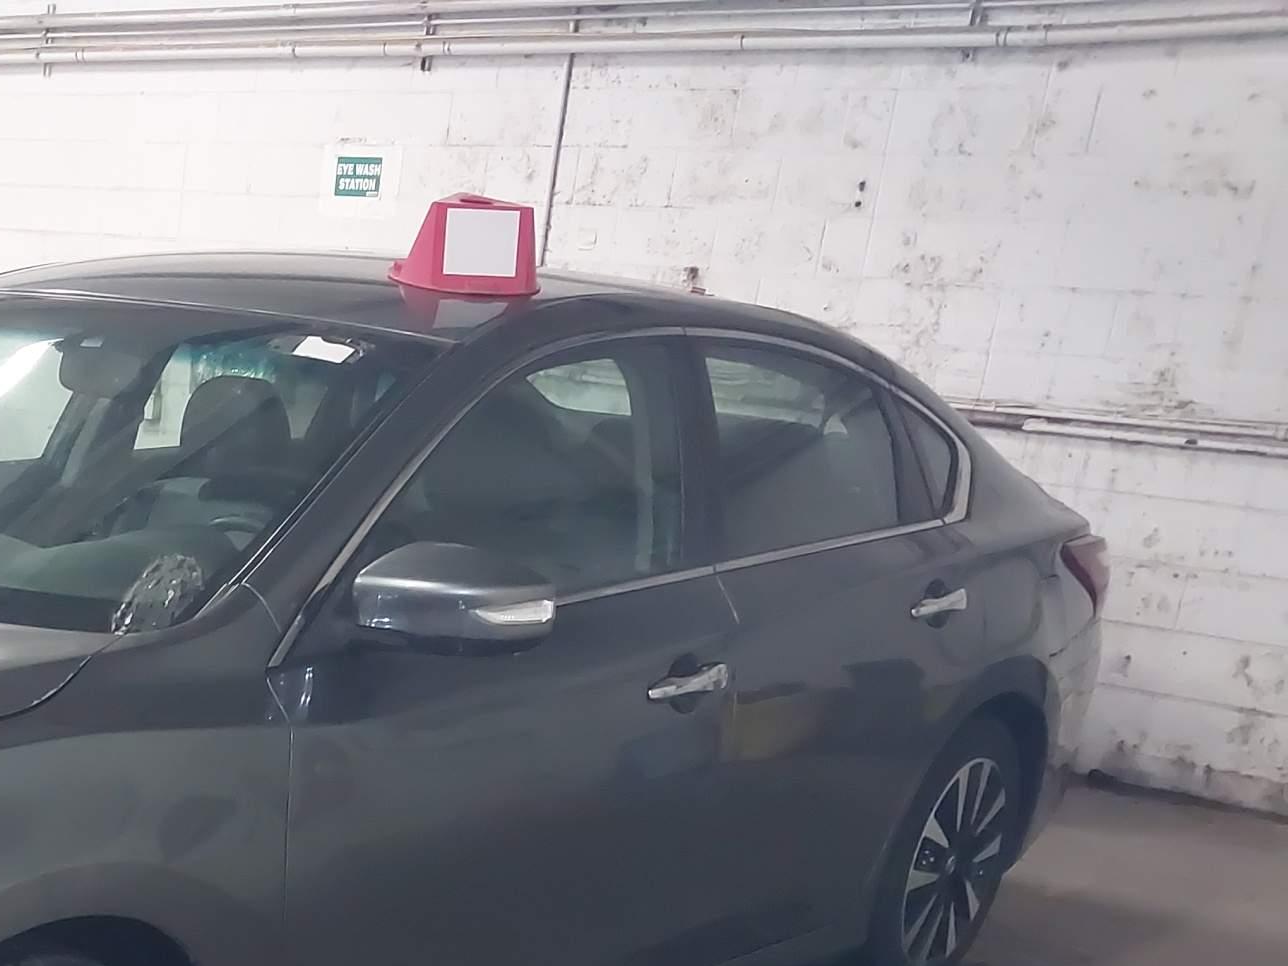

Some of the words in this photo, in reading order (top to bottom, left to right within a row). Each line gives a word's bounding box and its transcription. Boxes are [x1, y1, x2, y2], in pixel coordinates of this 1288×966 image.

[337, 164, 354, 176] EYE
[355, 164, 381, 176] WASH
[338, 178, 376, 191] STATION
